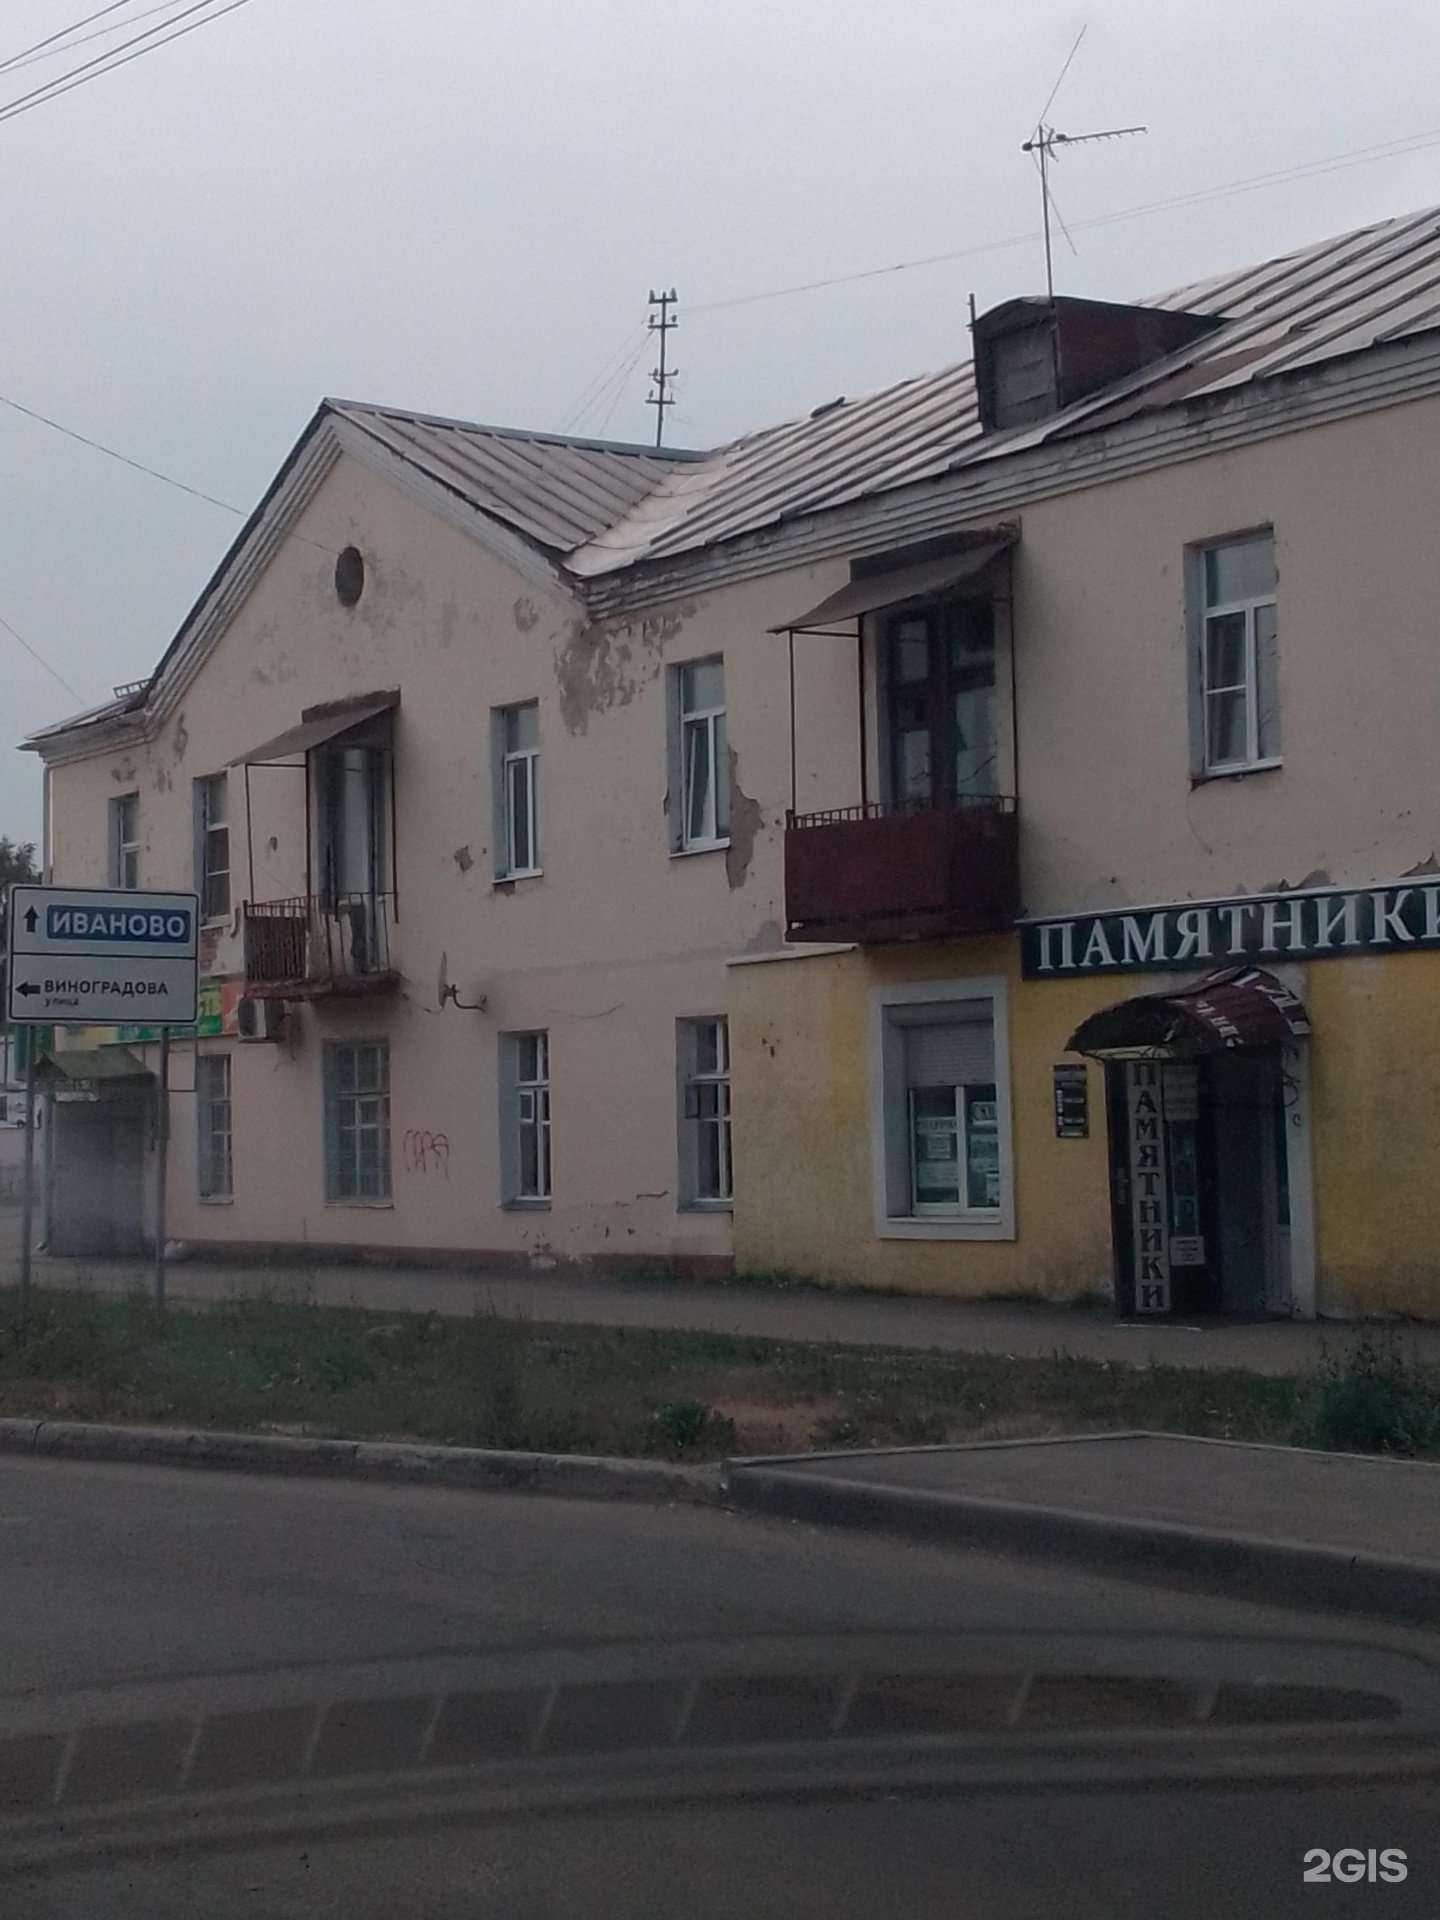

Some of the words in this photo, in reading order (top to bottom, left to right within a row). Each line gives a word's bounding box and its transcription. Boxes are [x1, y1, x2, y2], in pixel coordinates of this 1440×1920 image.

[52, 911, 186, 938] ИВАНОВО
[44, 979, 169, 997] ВИНОГРАДОВА
[44, 997, 79, 1007] улица
[1133, 1063, 1165, 1308] ПАМЯТНИКИ
